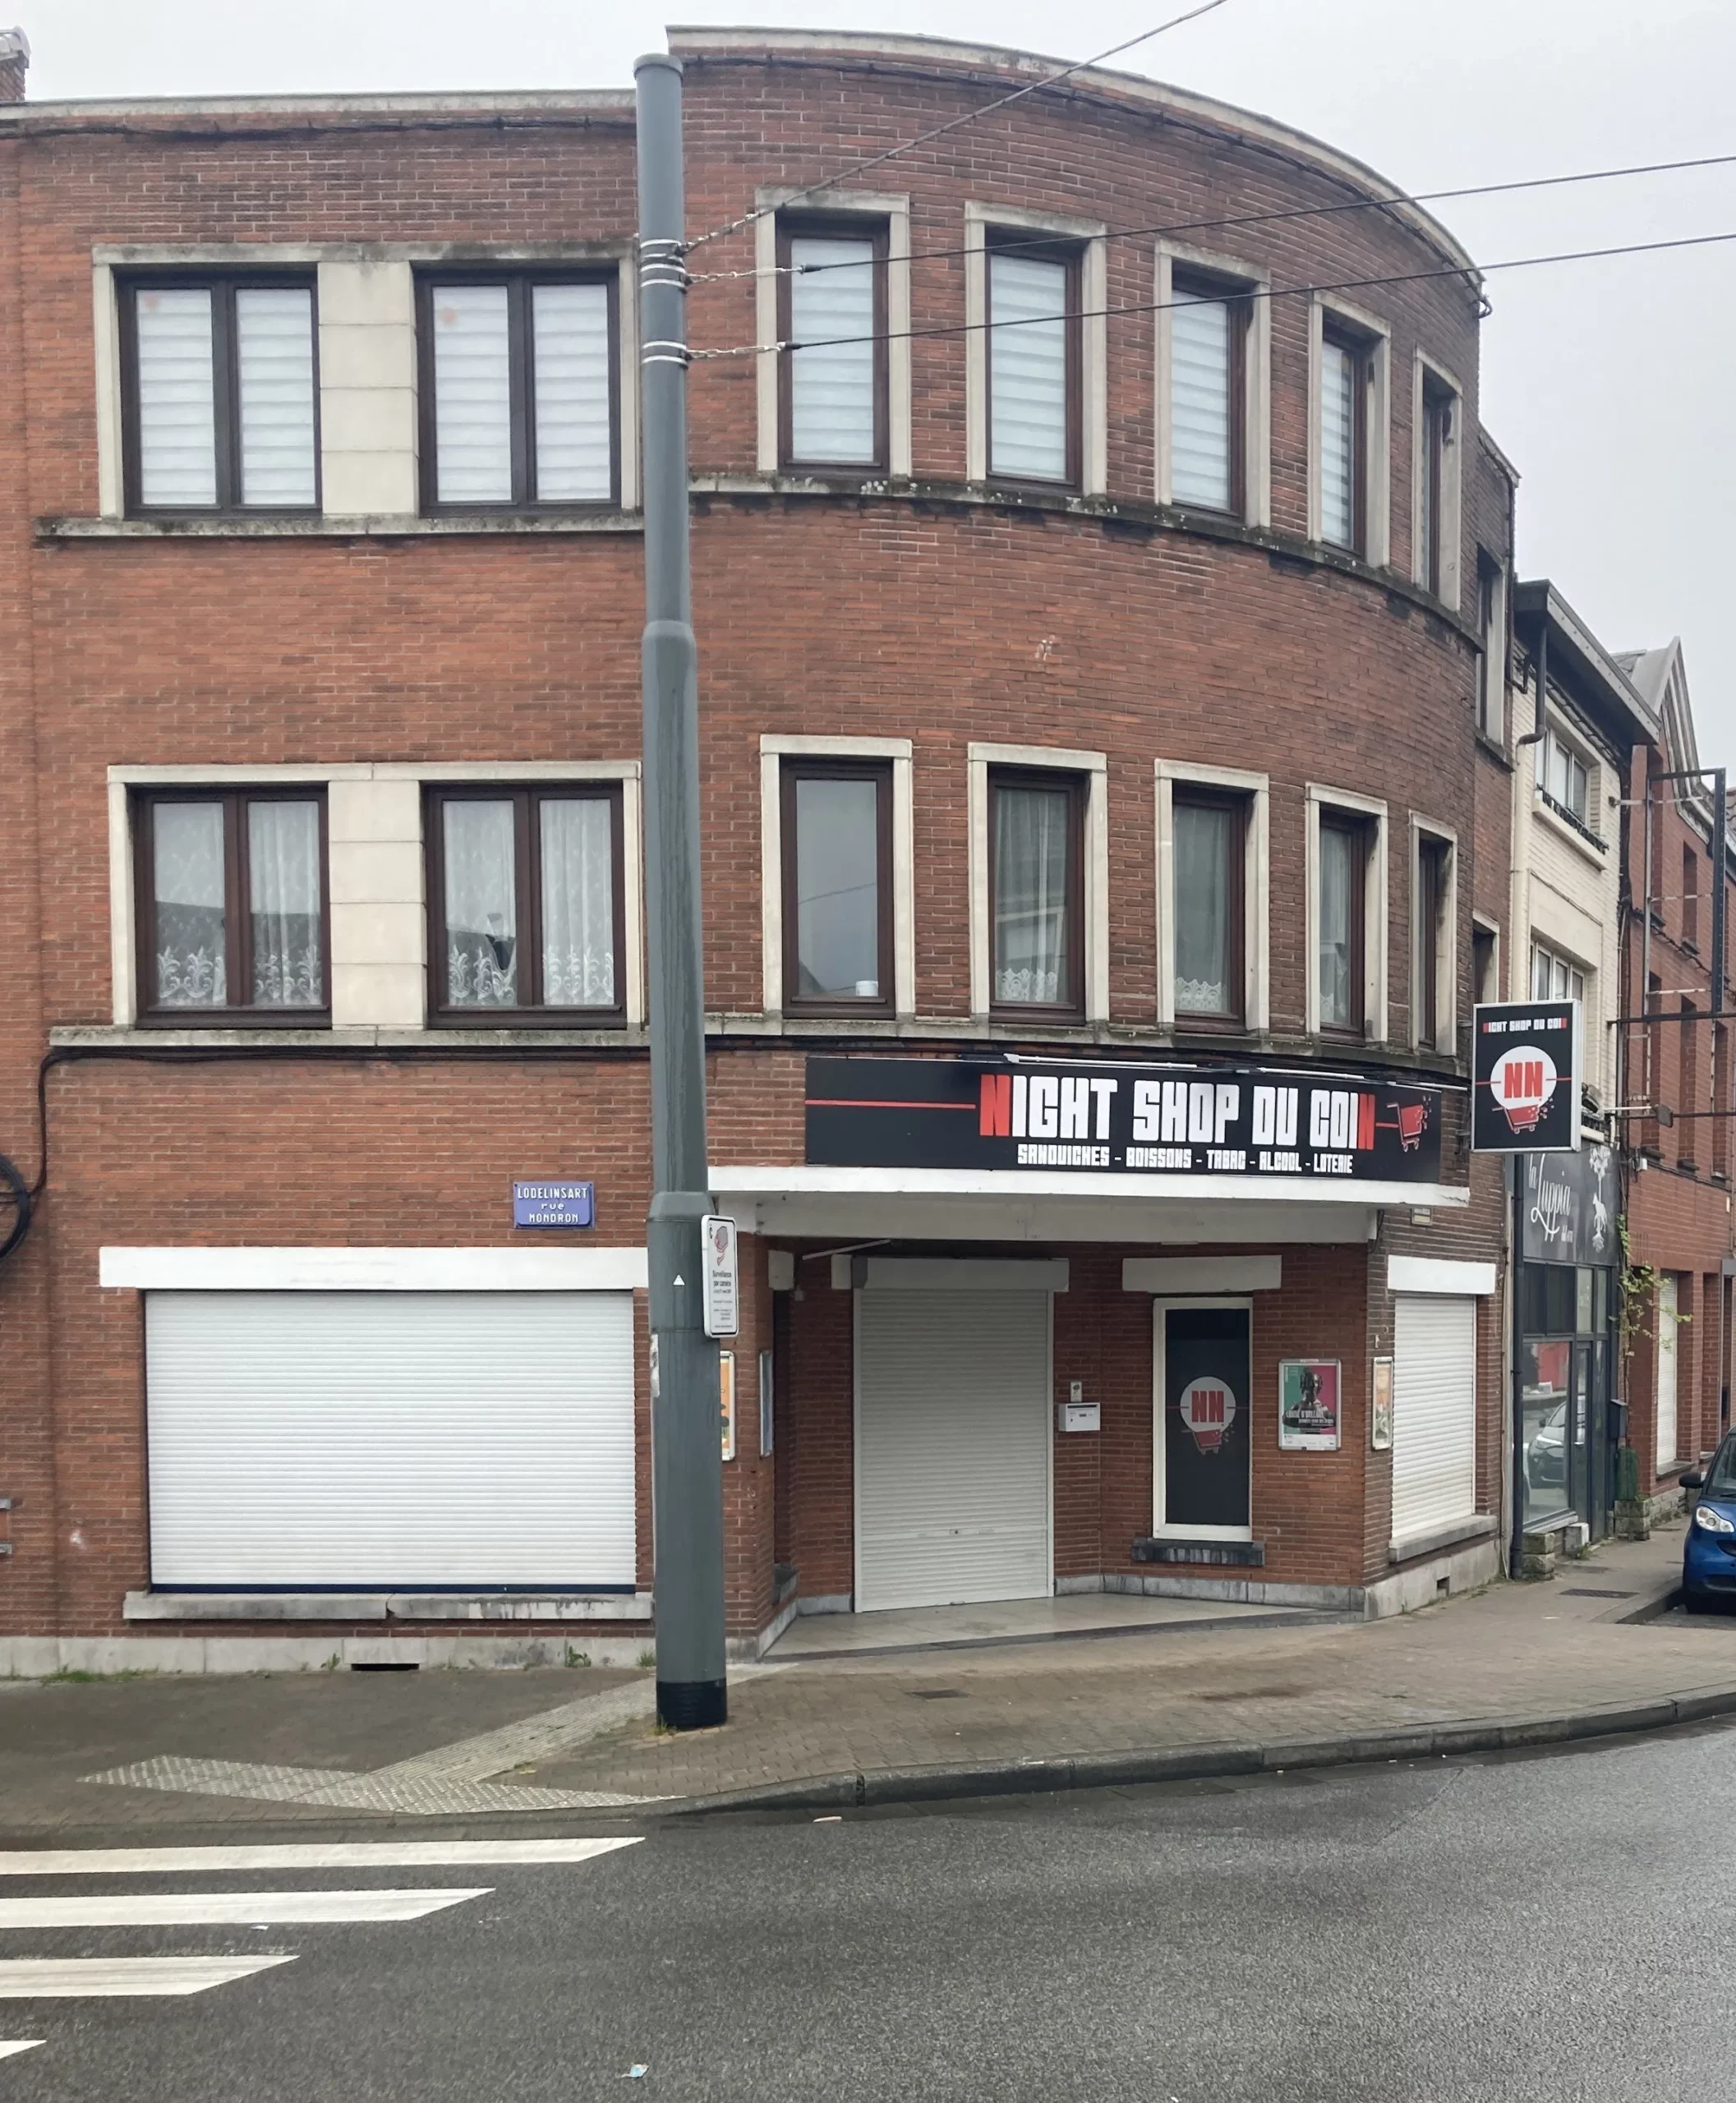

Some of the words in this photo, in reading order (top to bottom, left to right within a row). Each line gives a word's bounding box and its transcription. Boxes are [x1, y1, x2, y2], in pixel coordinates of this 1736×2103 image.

[1504, 1061, 1543, 1099] NN
[979, 1074, 1118, 1140] NIGHT
[1133, 1080, 1240, 1144] SHOP
[1252, 1085, 1298, 1146] DU
[1310, 1089, 1375, 1150] COIN
[1126, 1147, 1192, 1169] BOISSONS
[1206, 1149, 1246, 1170] TABAC
[1259, 1151, 1302, 1171] ALCOOL
[1314, 1153, 1353, 1173] LOTERIE
[518, 1187, 587, 1199] LODELINSART
[528, 1213, 578, 1223] MONDRON
[541, 1203, 564, 1211] rue
[1191, 1390, 1224, 1423] NN
